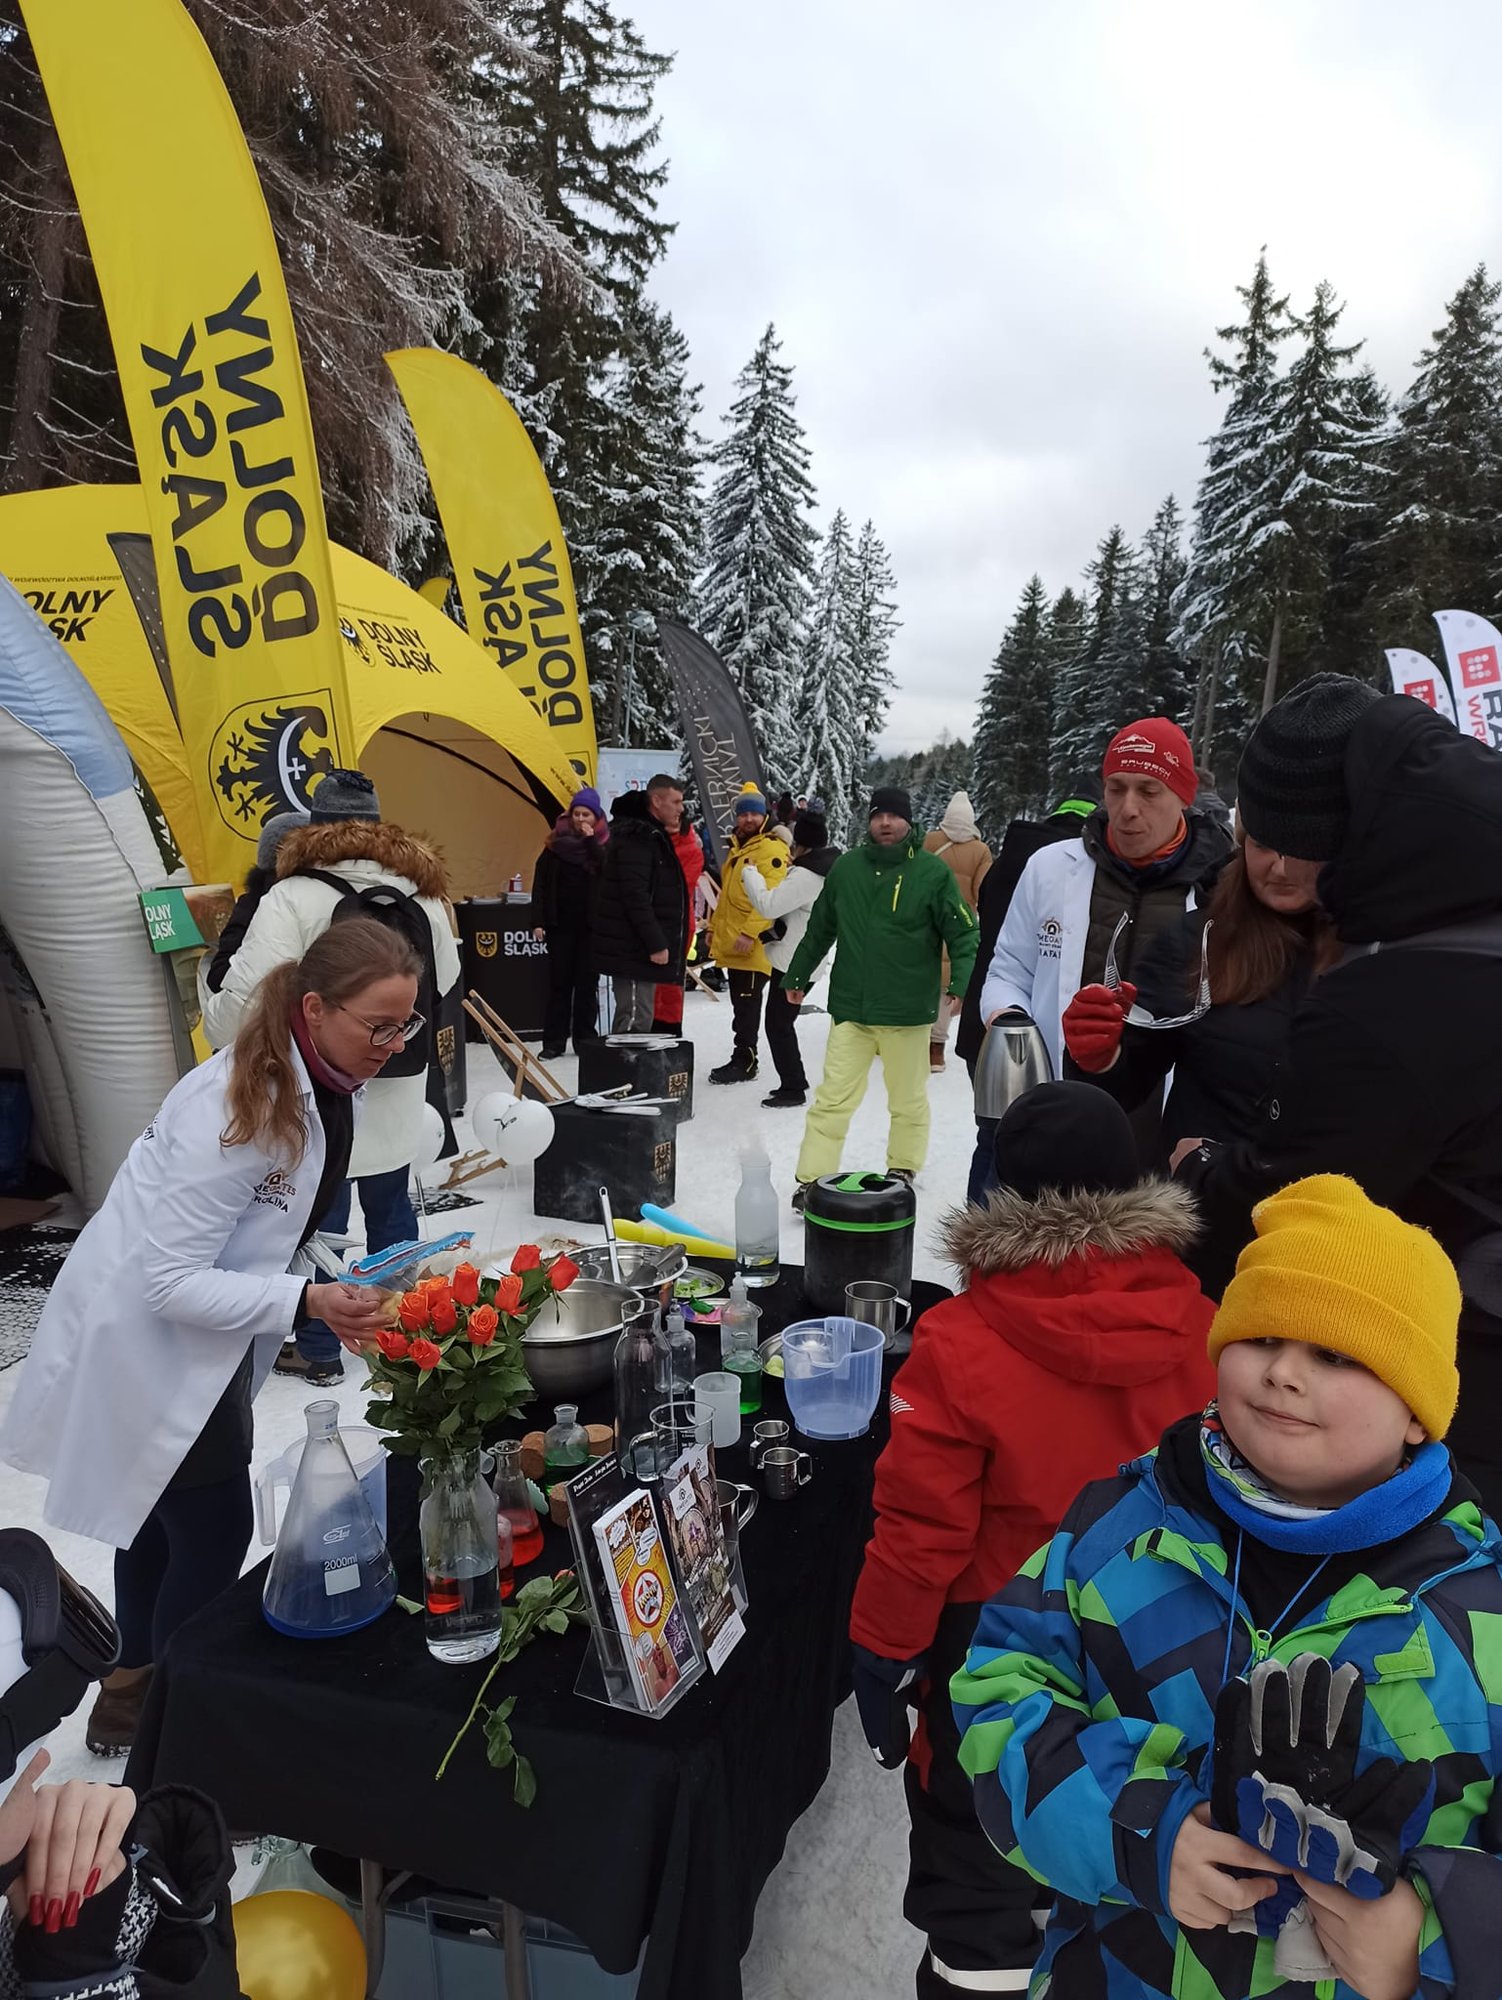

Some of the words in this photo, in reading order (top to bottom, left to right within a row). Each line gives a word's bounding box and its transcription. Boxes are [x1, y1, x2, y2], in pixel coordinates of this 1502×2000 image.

[357, 618, 426, 649] DOLNY
[376, 640, 442, 675] ŚLĄSK
[503, 930, 546, 943] DOL
[252, 1195, 288, 1213] ROLINA
[324, 1553, 358, 1571] 2000ml
